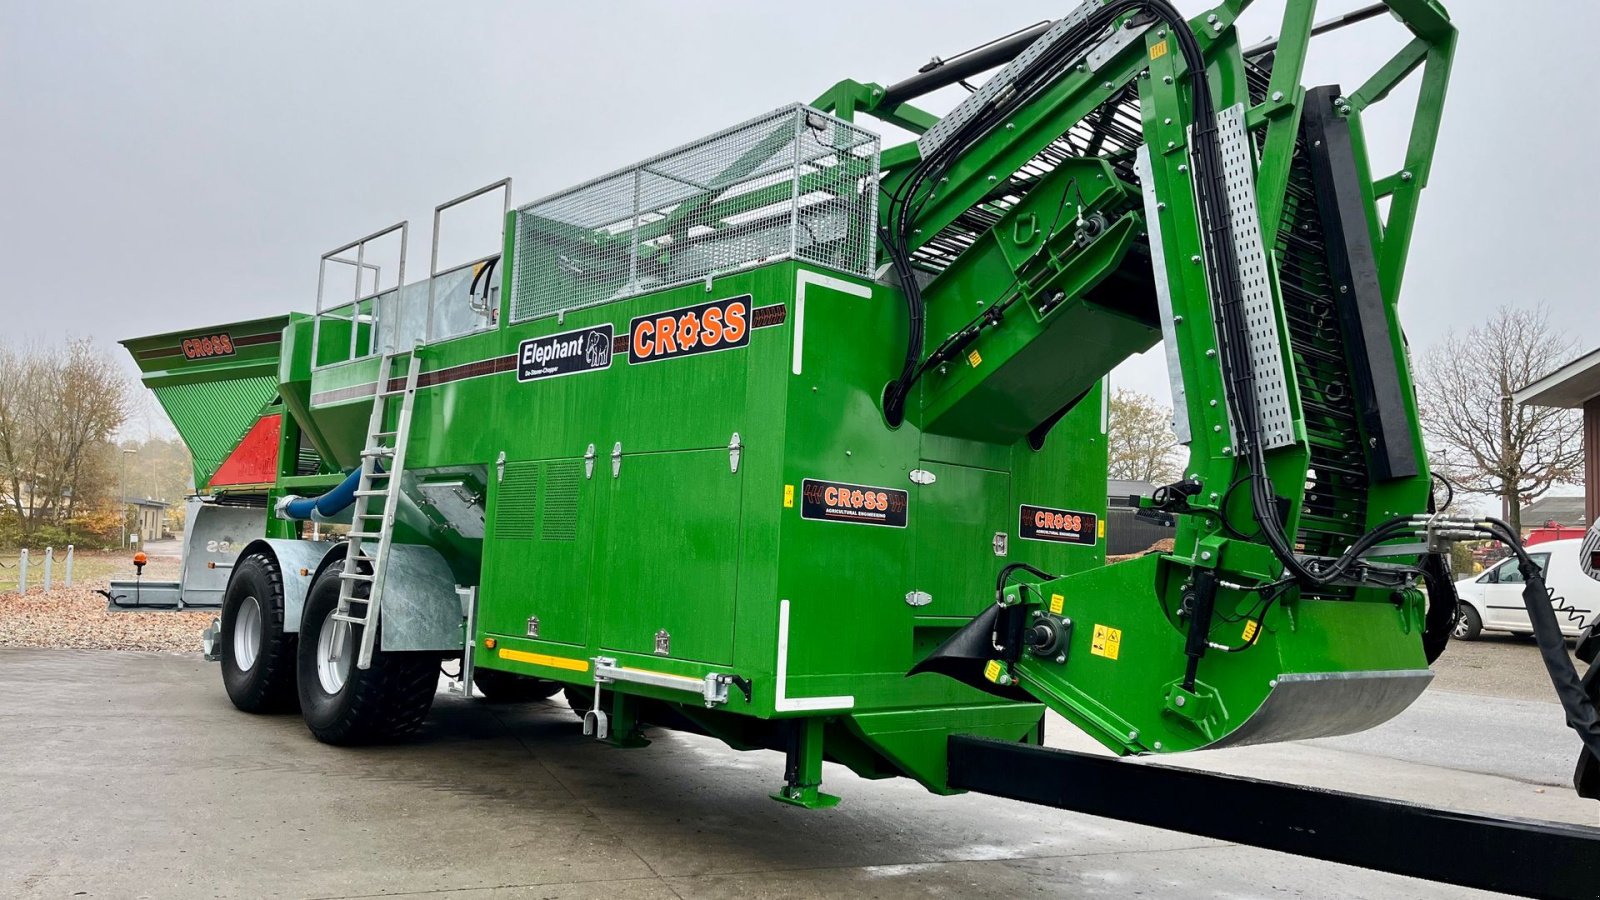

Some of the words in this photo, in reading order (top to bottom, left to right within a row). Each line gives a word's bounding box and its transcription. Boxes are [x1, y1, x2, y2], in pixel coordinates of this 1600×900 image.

[633, 302, 746, 358] CROSS
[183, 334, 233, 358] CROSS
[522, 335, 584, 366] Elephant
[824, 486, 888, 511] CROSS
[1035, 511, 1082, 532] CROSS
